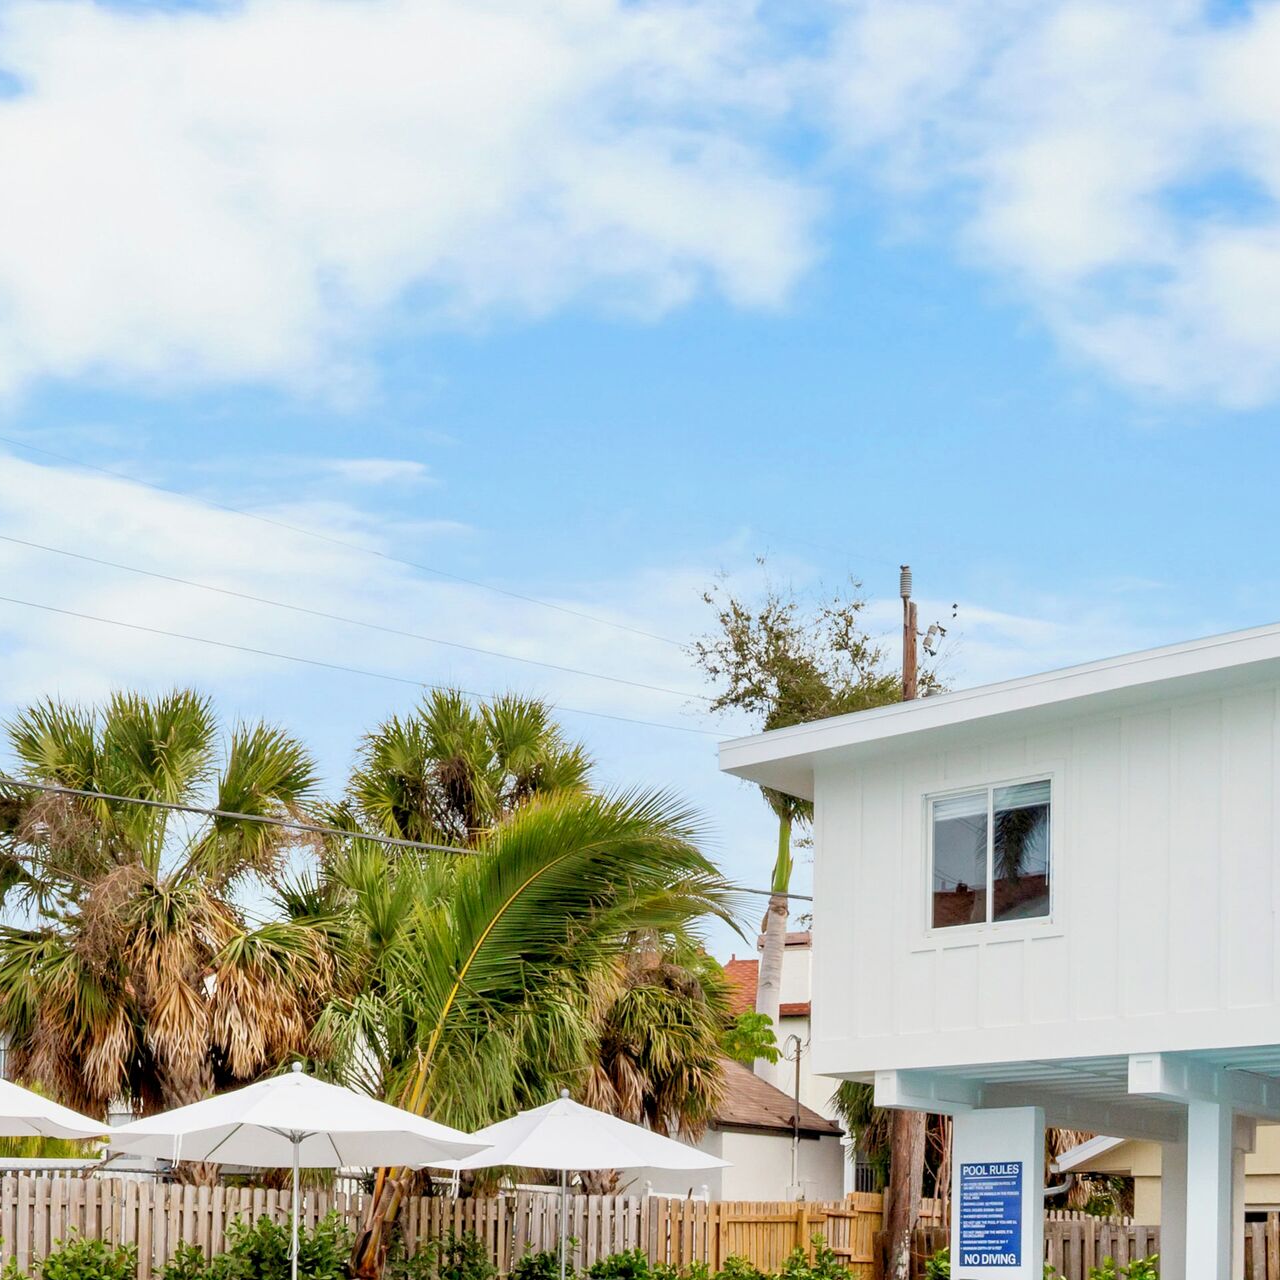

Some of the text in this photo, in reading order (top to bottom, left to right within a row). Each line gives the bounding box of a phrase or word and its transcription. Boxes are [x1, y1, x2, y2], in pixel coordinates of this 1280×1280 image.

[963, 1164, 1019, 1176] POOL RULES
[964, 1253, 1016, 1265] NO DIVING
